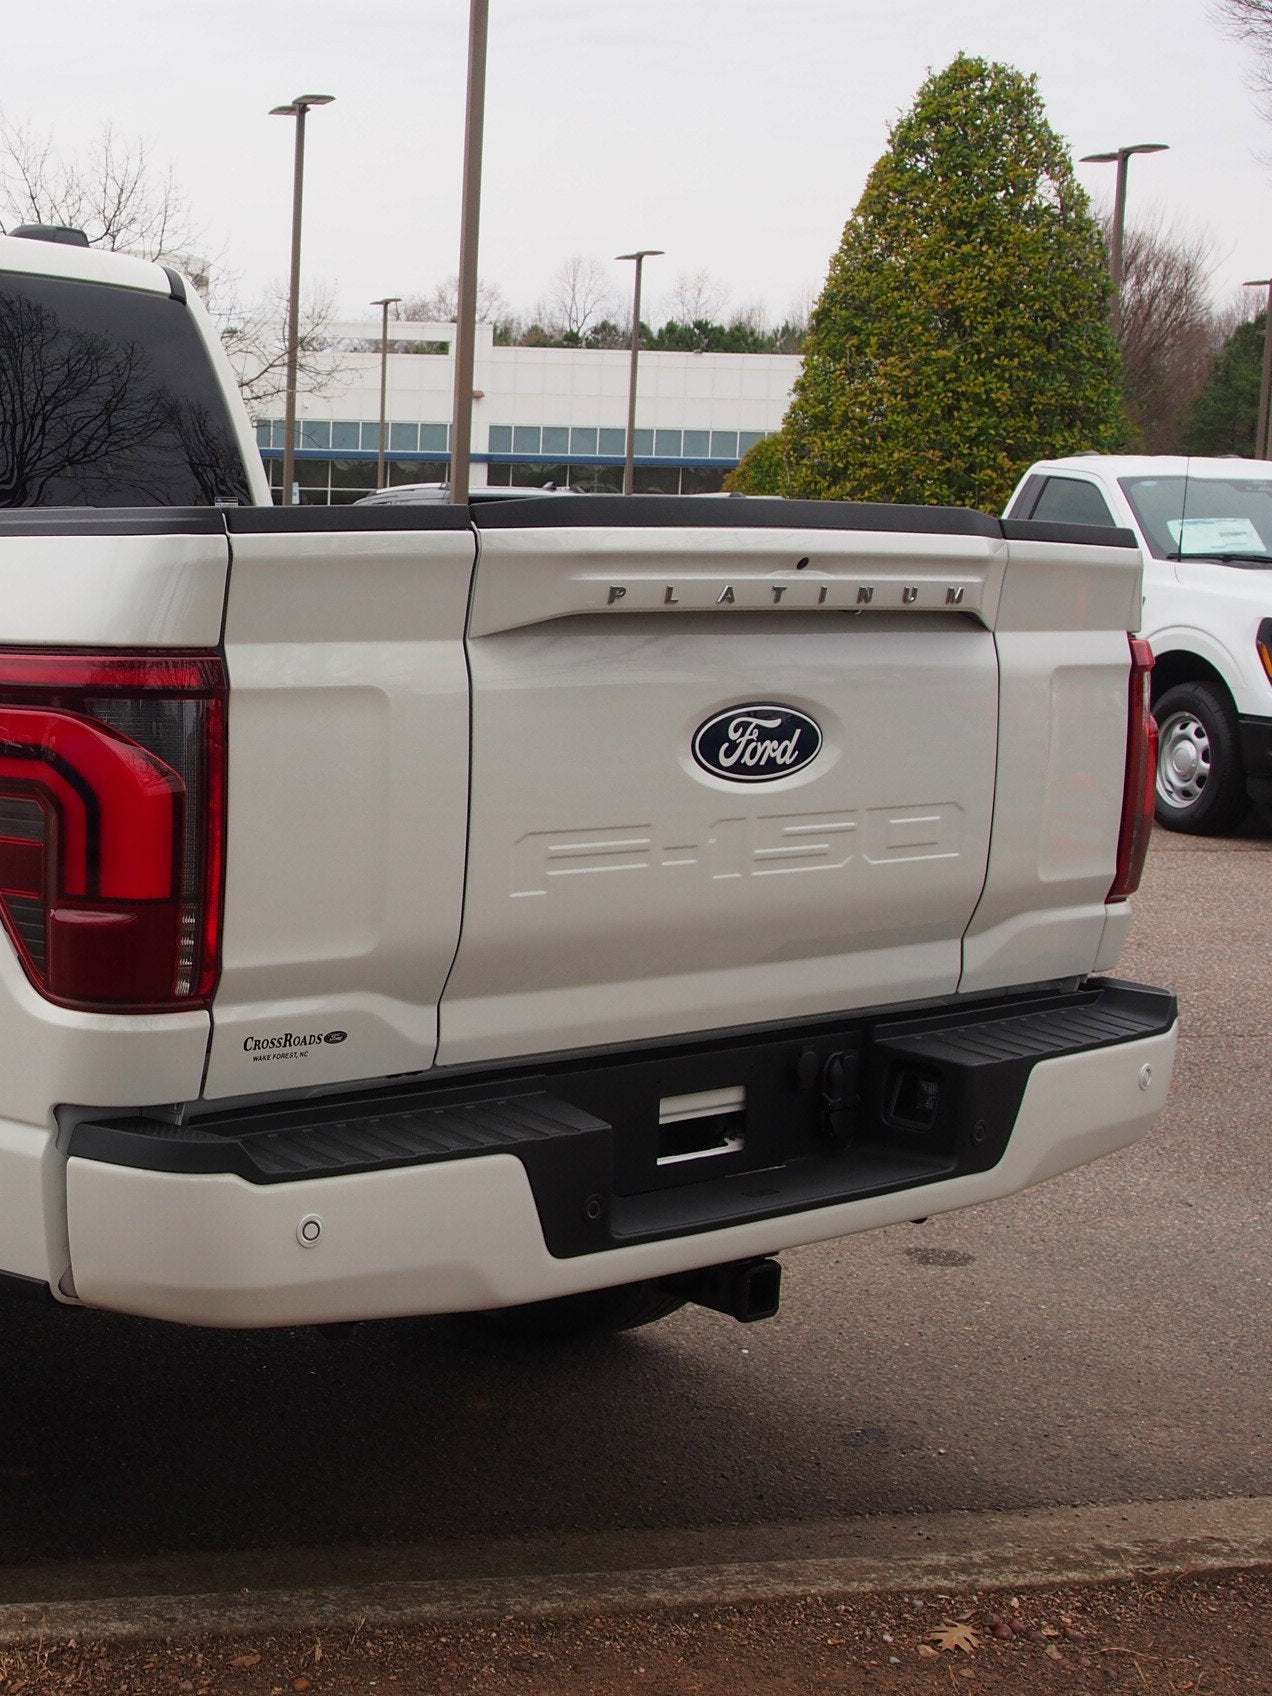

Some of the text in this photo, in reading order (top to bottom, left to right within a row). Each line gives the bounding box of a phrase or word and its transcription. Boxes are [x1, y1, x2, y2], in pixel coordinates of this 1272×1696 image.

[607, 584, 964, 606] PLATINUM
[718, 716, 802, 767] Ford
[510, 801, 965, 898] F-150
[272, 1051, 298, 1060] FOREST,
